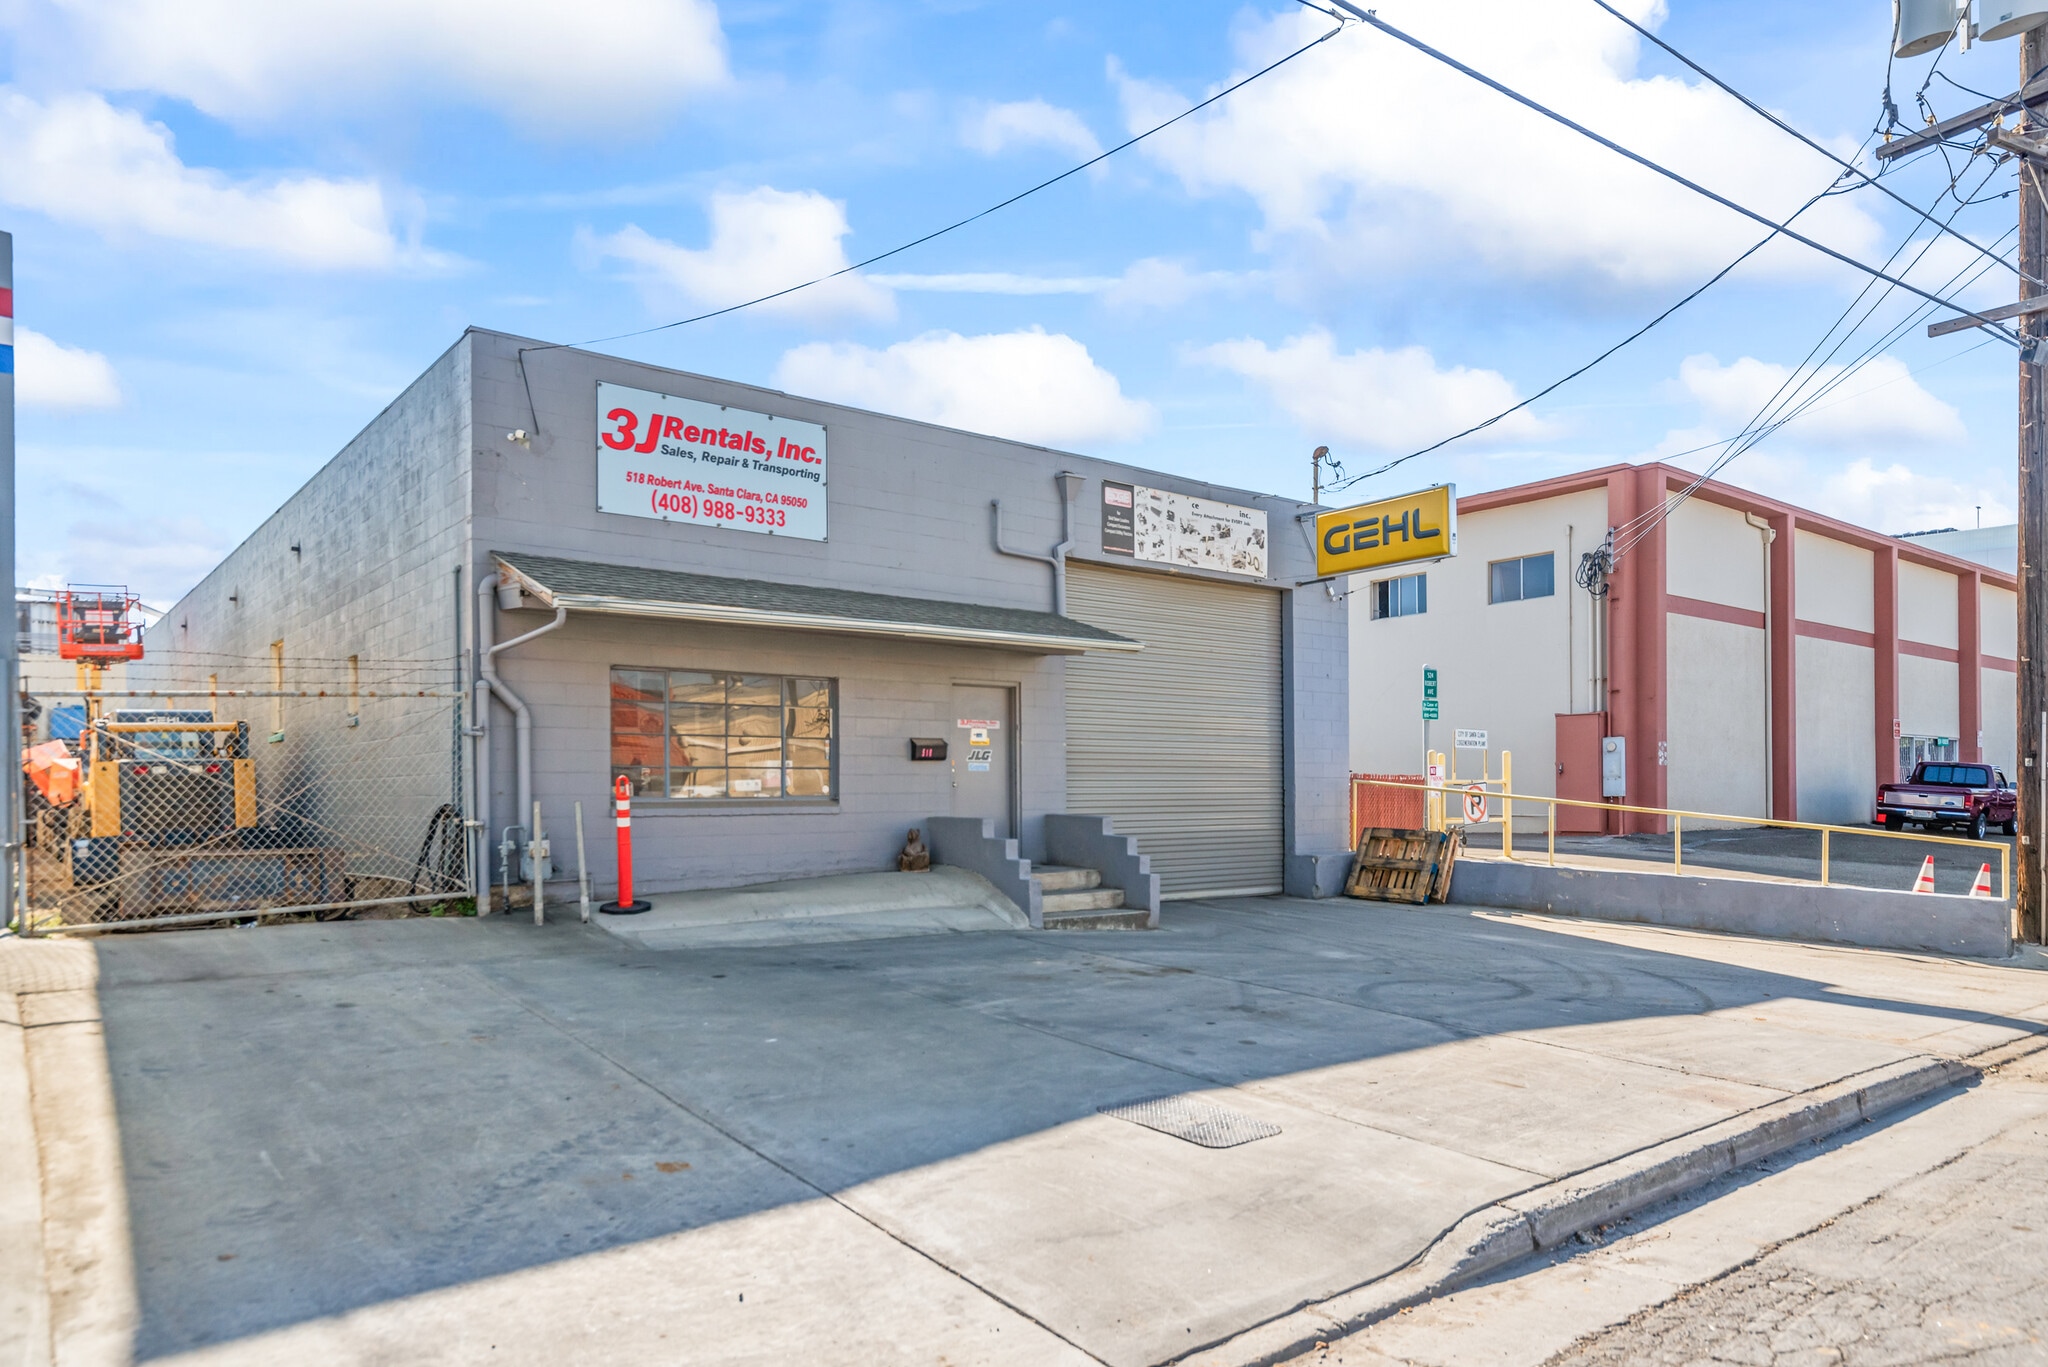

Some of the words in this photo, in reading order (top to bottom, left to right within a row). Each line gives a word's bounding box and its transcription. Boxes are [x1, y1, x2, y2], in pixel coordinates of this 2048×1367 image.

[601, 407, 664, 454] 3J
[663, 415, 772, 461] Rentals,
[777, 437, 822, 465] Inc.
[660, 444, 697, 463] Sales,
[701, 451, 740, 468] Repair
[742, 458, 749, 468] &
[752, 460, 820, 483] Transporting
[626, 471, 645, 484] 518
[647, 474, 682, 490] Robert
[683, 480, 705, 493] Ave.
[707, 483, 735, 498] Santa
[736, 488, 763, 503] Clara,
[765, 492, 779, 504] CA
[780, 496, 808, 508] 95050
[651, 489, 698, 519] (408)
[703, 499, 786, 527] 988-9333
[1323, 507, 1441, 555] GEHL
[968, 751, 991, 761] JLG
